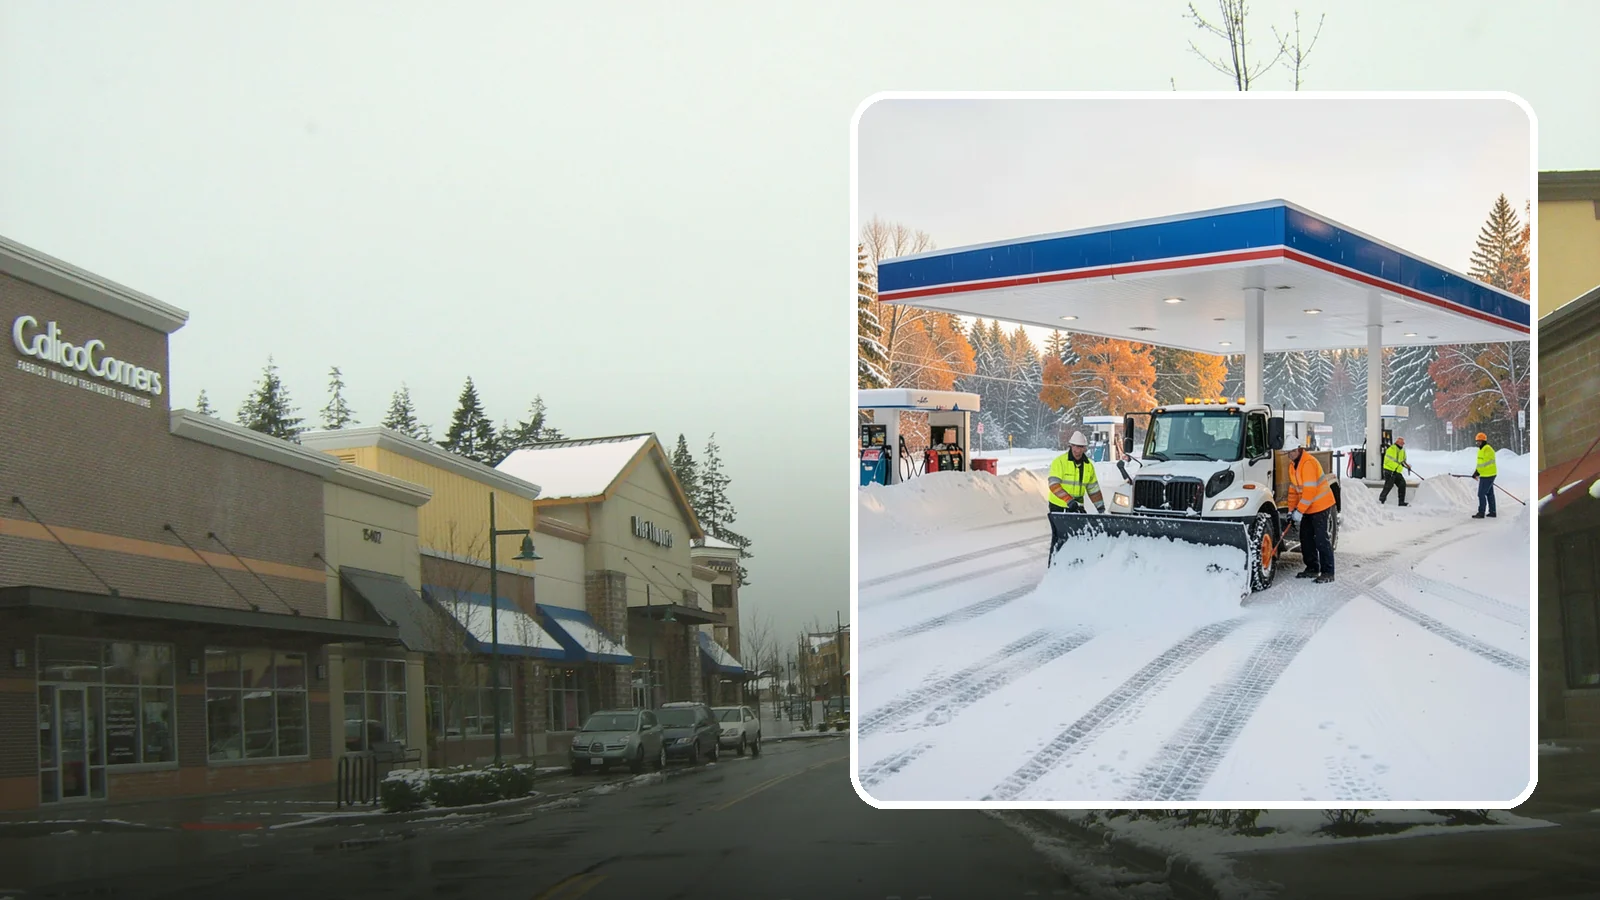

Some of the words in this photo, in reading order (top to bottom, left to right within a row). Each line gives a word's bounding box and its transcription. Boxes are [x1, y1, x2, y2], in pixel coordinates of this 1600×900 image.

[17, 360, 47, 377] FABRICS
[51, 371, 78, 386] WINDOW
[78, 379, 116, 398] TREATMENTS
[120, 392, 151, 408] FURNITURE
